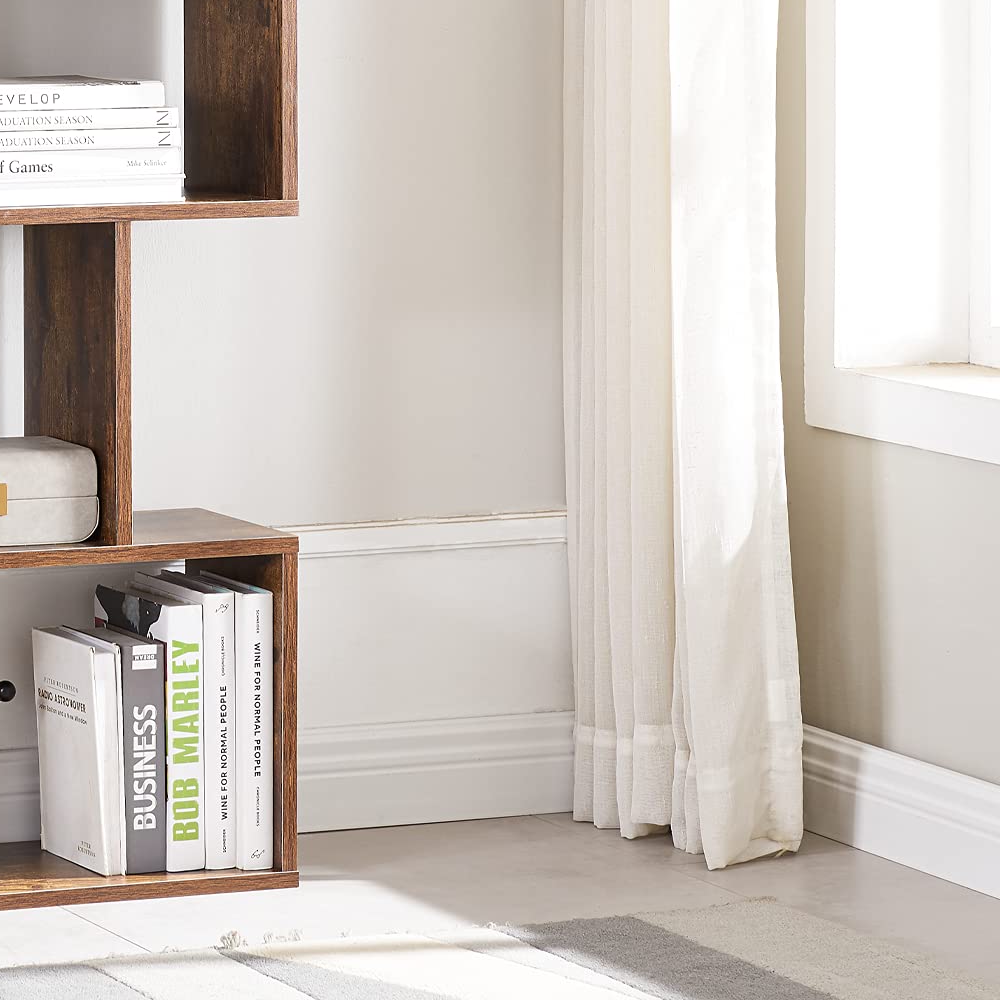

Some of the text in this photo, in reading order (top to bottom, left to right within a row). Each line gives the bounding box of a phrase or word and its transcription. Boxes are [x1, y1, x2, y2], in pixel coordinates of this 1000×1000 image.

[54, 115, 93, 125] SEASON
[55, 135, 95, 145] SEASON
[8, 160, 54, 174] Games
[220, 686, 228, 724] PEOPLE
[253, 643, 261, 777] WINE FOR NORMAL PEOPLE
[172, 639, 200, 842] BOB MARLEY
[220, 726, 228, 769] NORMAL
[132, 704, 158, 831] BUSINESS
